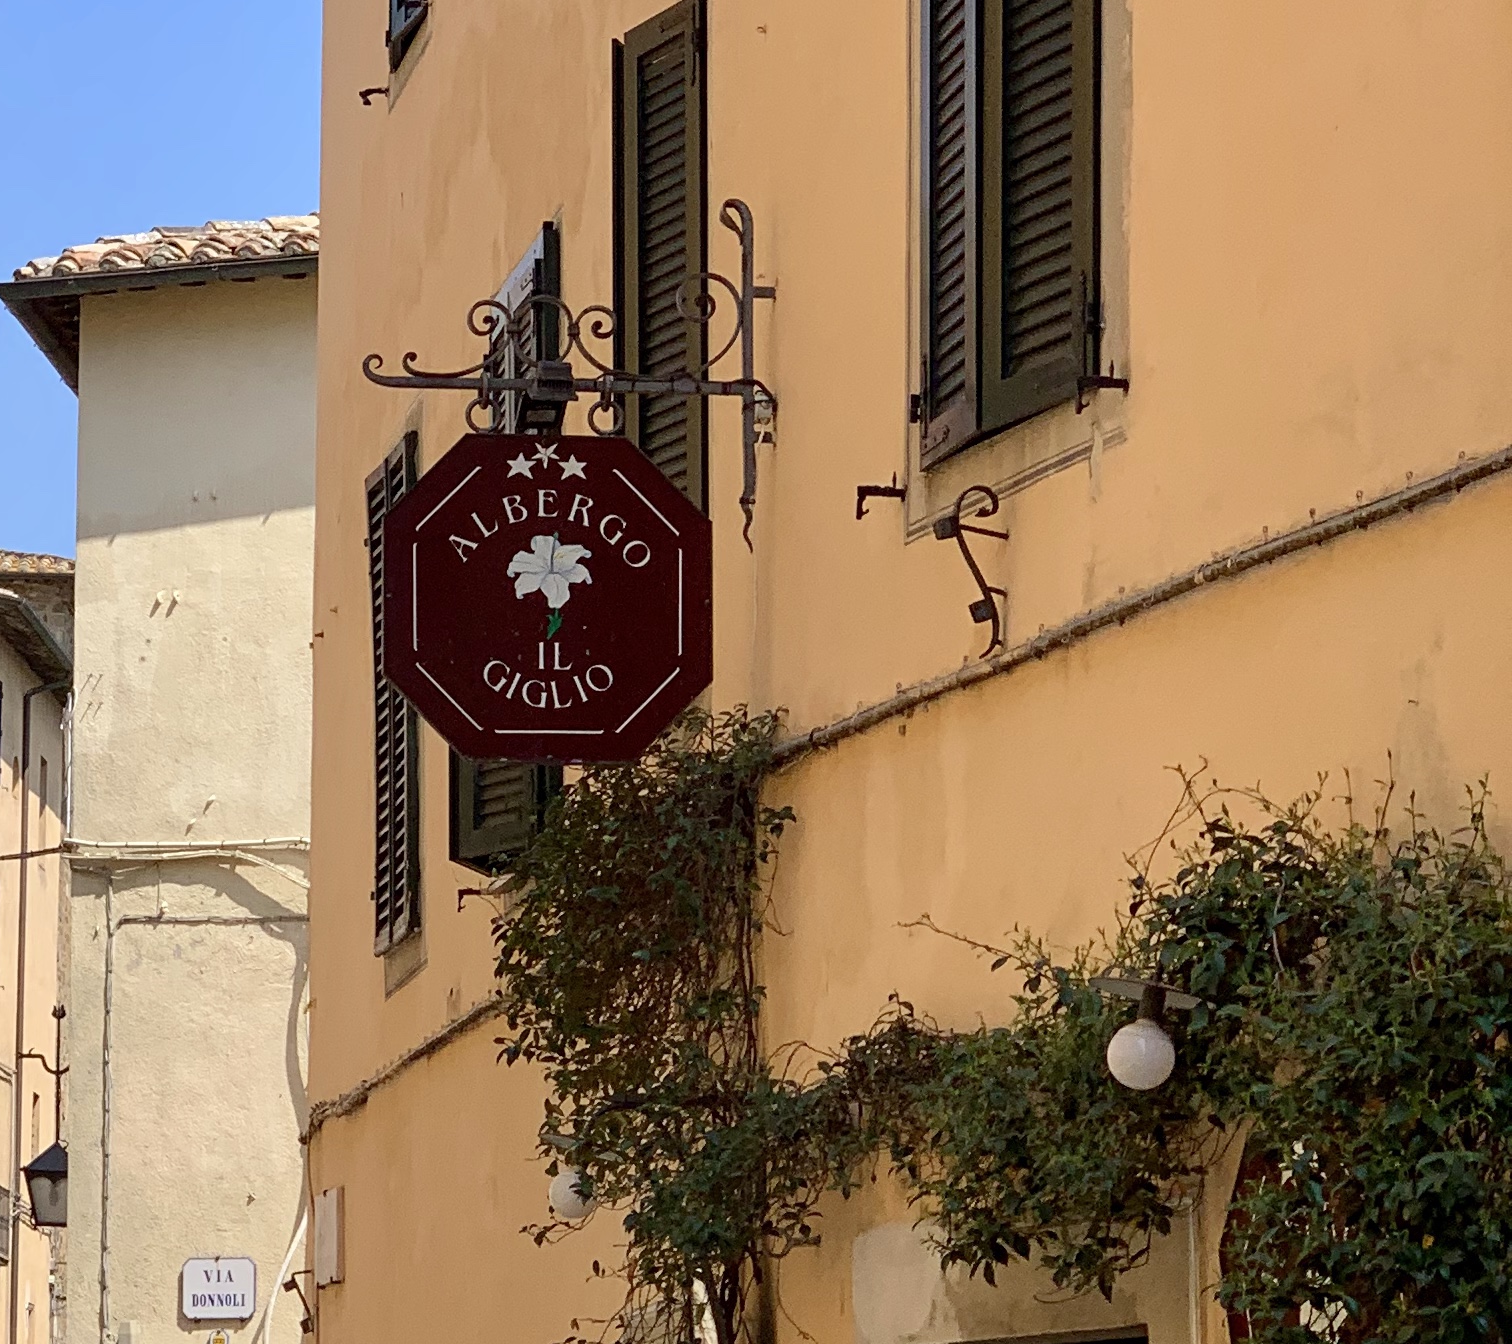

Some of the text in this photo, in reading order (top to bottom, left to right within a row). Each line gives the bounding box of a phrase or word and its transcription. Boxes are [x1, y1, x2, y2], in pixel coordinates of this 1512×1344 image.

[448, 488, 652, 568] ALBERGO
[537, 641, 573, 671] IL
[482, 659, 614, 709] GIGLIO
[203, 1269, 234, 1283] VIA
[192, 1293, 246, 1307] DONNOLI
